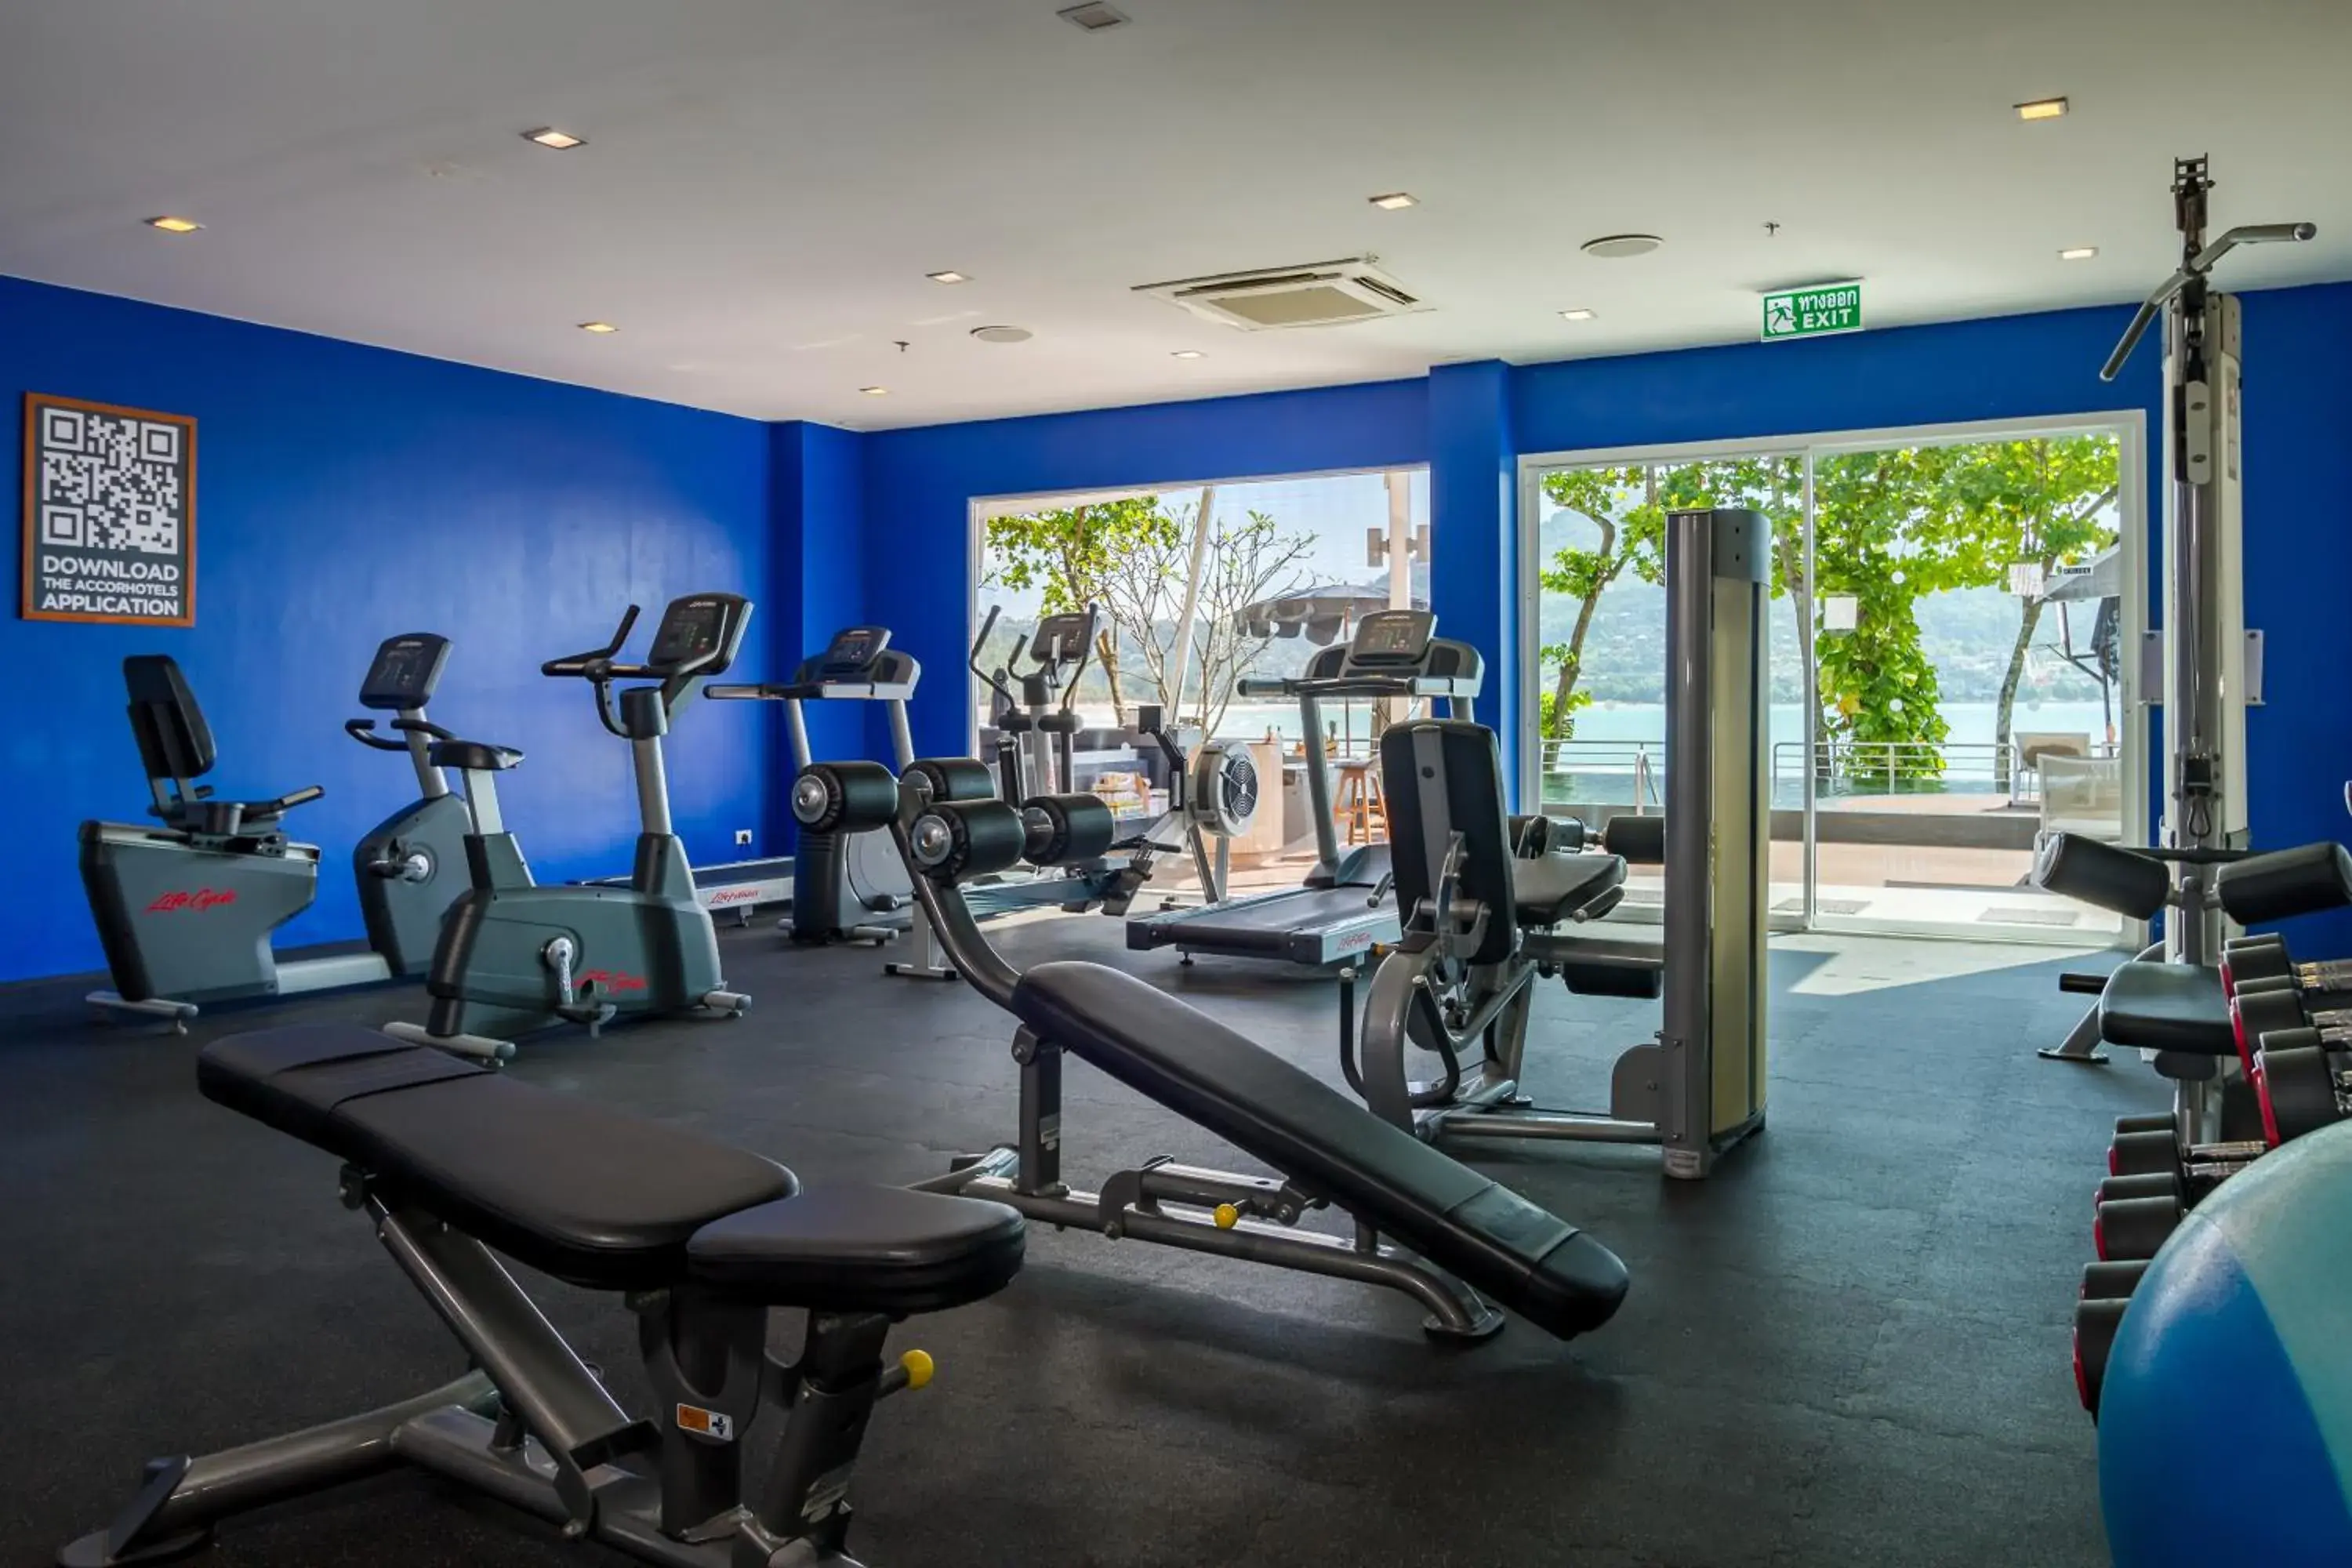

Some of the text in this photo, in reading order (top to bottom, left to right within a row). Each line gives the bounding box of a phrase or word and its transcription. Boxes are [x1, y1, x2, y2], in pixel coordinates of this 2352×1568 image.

[1798, 290, 1857, 310] ทางออก
[1803, 309, 1853, 328] EXIT
[42, 555, 179, 581] DOWNLOAD
[42, 576, 178, 597] THE ACCORHOTELS
[42, 592, 178, 615] APPLICATION
